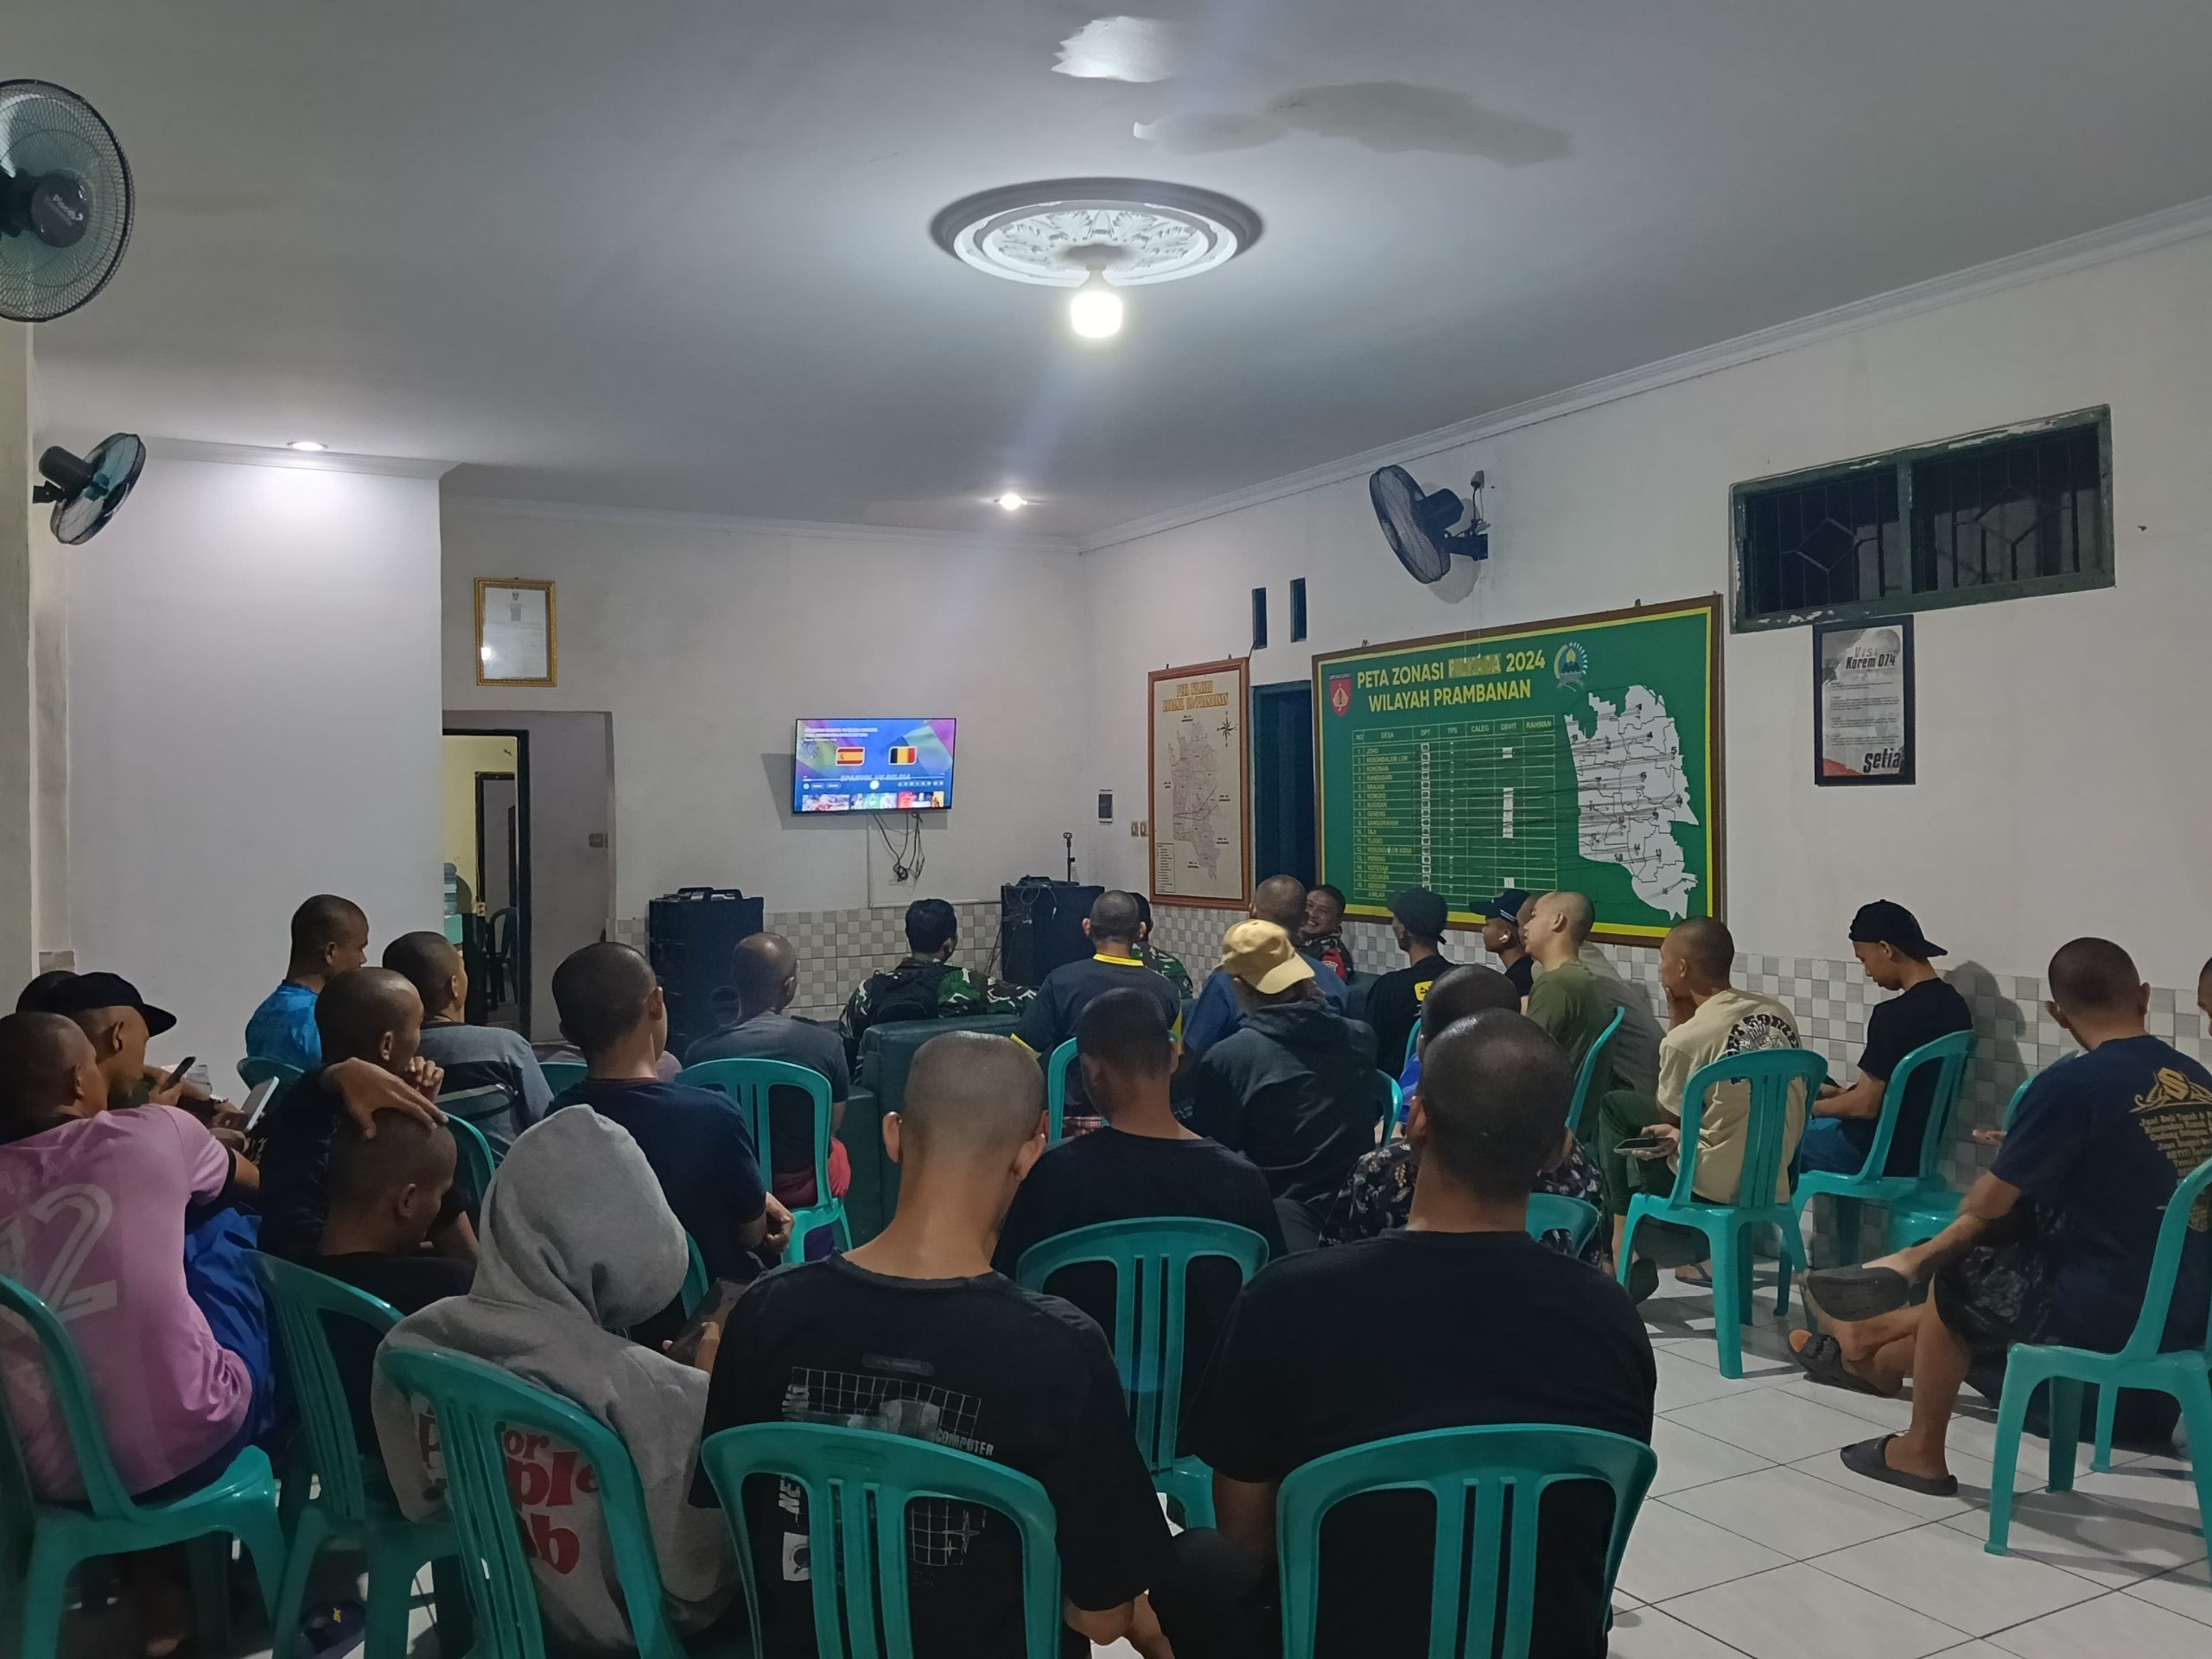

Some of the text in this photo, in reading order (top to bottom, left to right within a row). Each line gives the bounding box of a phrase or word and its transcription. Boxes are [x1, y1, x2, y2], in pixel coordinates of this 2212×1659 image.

[1357, 669, 1389, 690] PETA
[1392, 662, 1444, 685] ZONASI
[1506, 650, 1546, 672] 2024
[1846, 653, 1897, 670] Korem 074
[1369, 679, 1530, 712] WILAYAH PRAMBANAN
[1863, 748, 1901, 773] setia
[935, 1429, 995, 1457] COMPUTER
